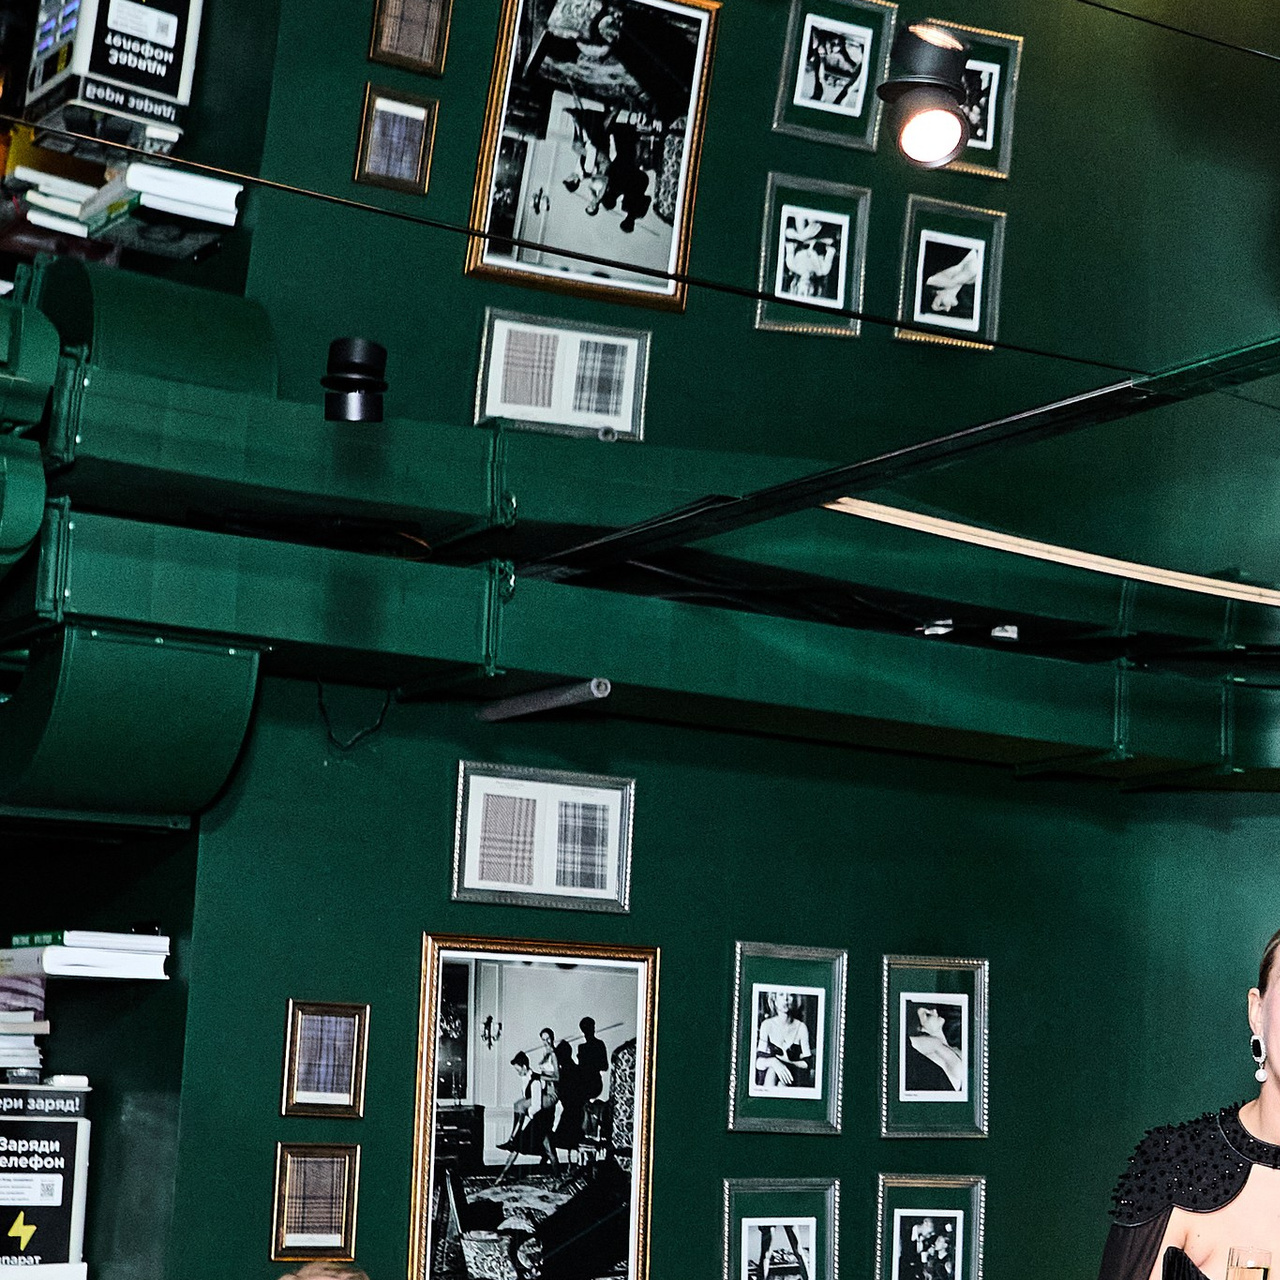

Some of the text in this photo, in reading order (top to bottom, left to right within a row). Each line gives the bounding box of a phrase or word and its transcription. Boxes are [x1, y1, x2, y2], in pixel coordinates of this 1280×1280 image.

[27, 1097, 80, 1113] заряд!
[0, 1136, 61, 1154] Заряди
[0, 1255, 42, 1266] парат
